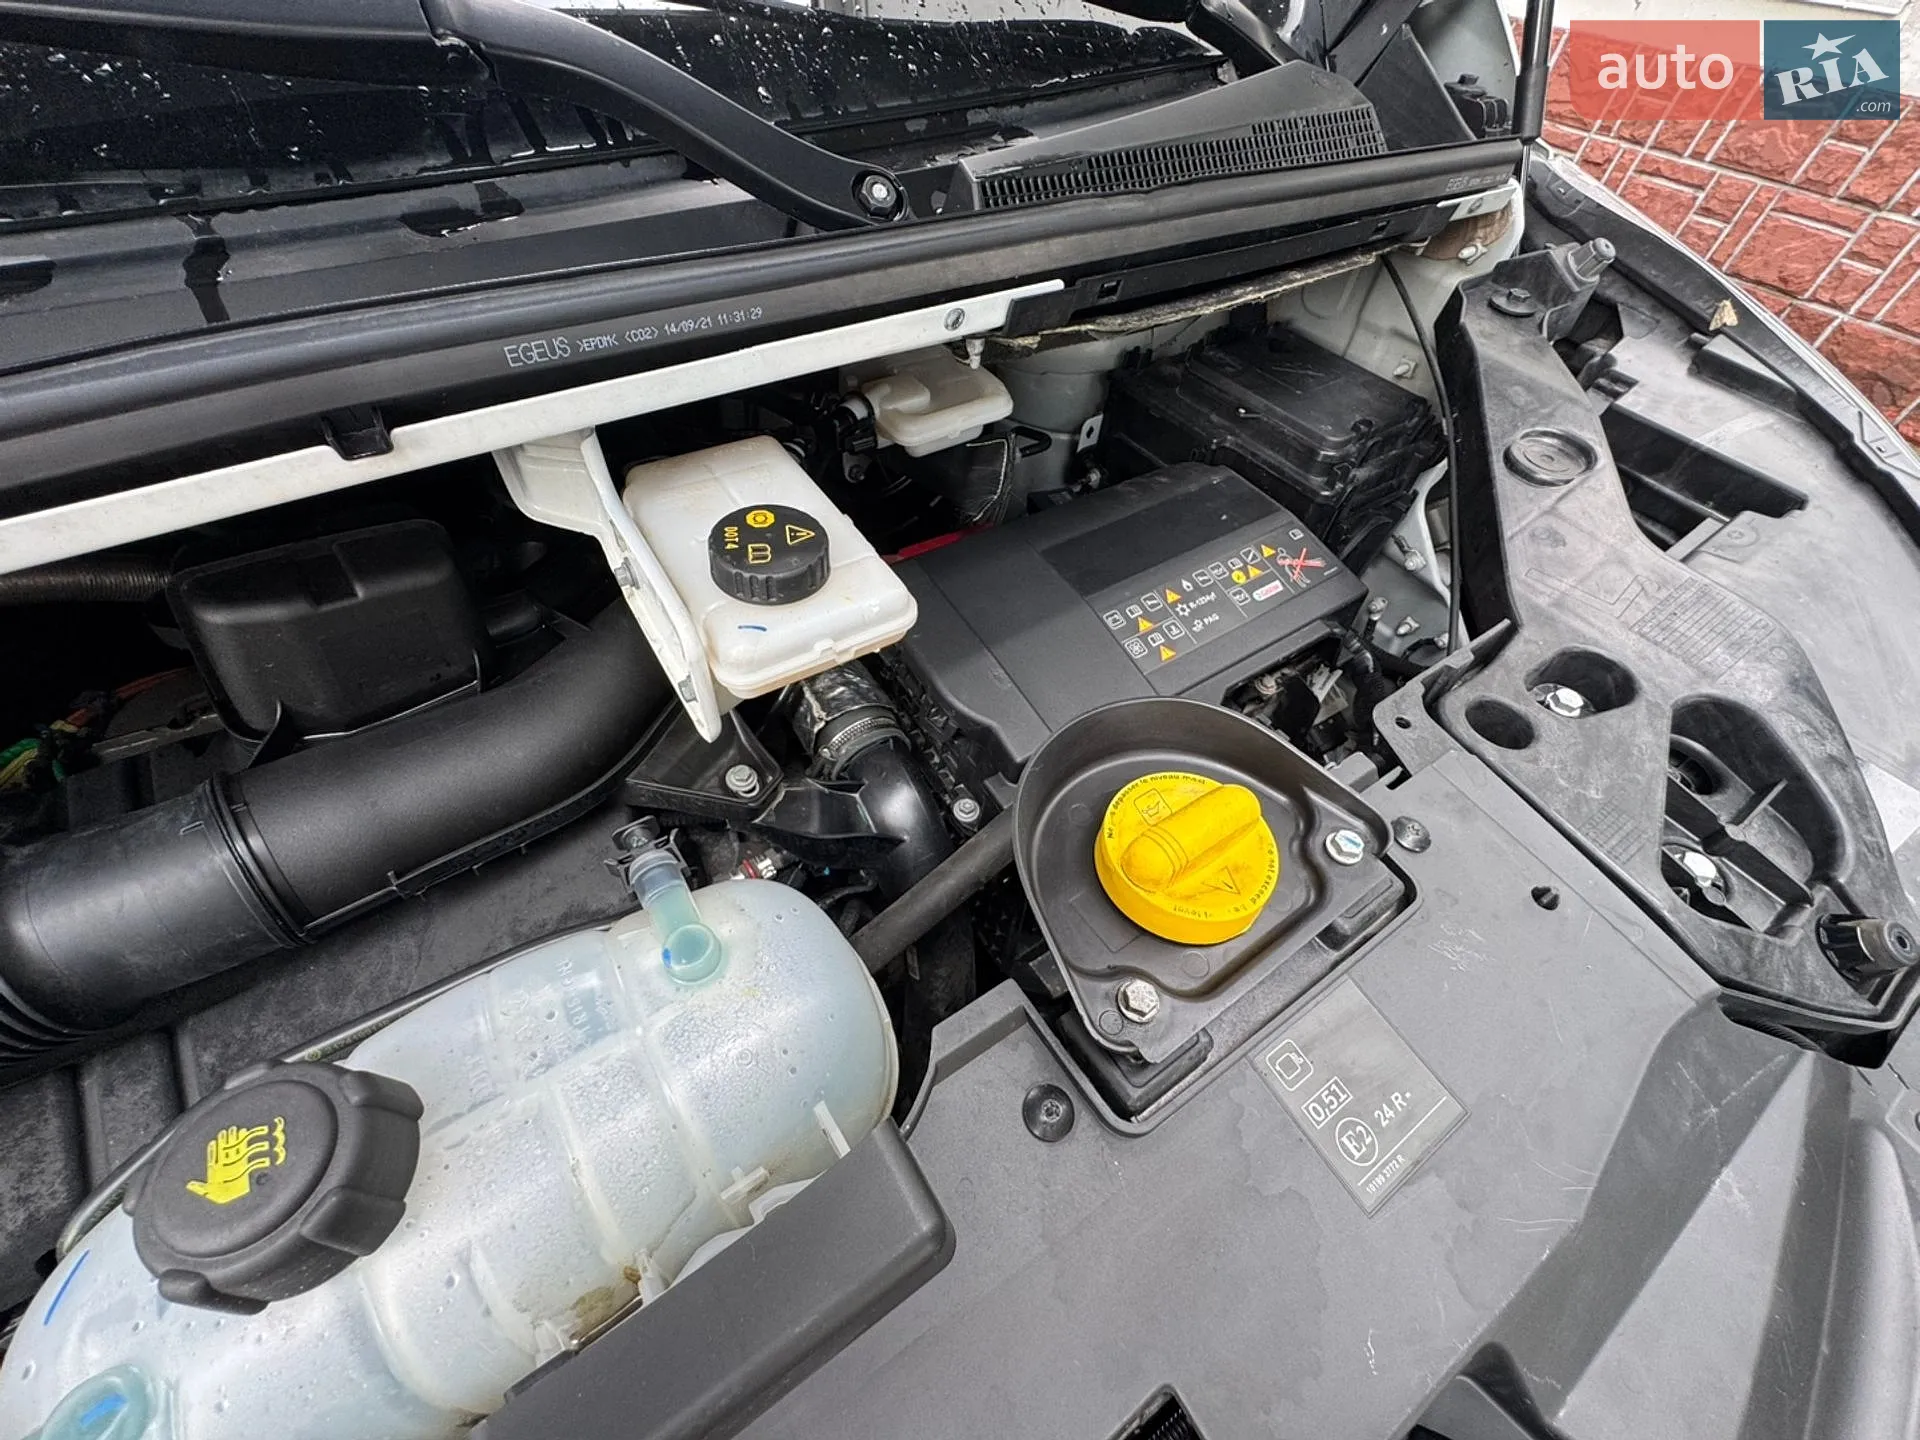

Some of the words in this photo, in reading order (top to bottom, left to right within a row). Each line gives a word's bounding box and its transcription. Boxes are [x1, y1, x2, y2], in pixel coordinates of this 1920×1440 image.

[503, 336, 570, 368] EGEUS
[664, 317, 713, 336] 14/09/21
[718, 307, 763, 326] 11:31:29
[1308, 1083, 1348, 1122] 0,51
[1374, 1103, 1395, 1127] 24
